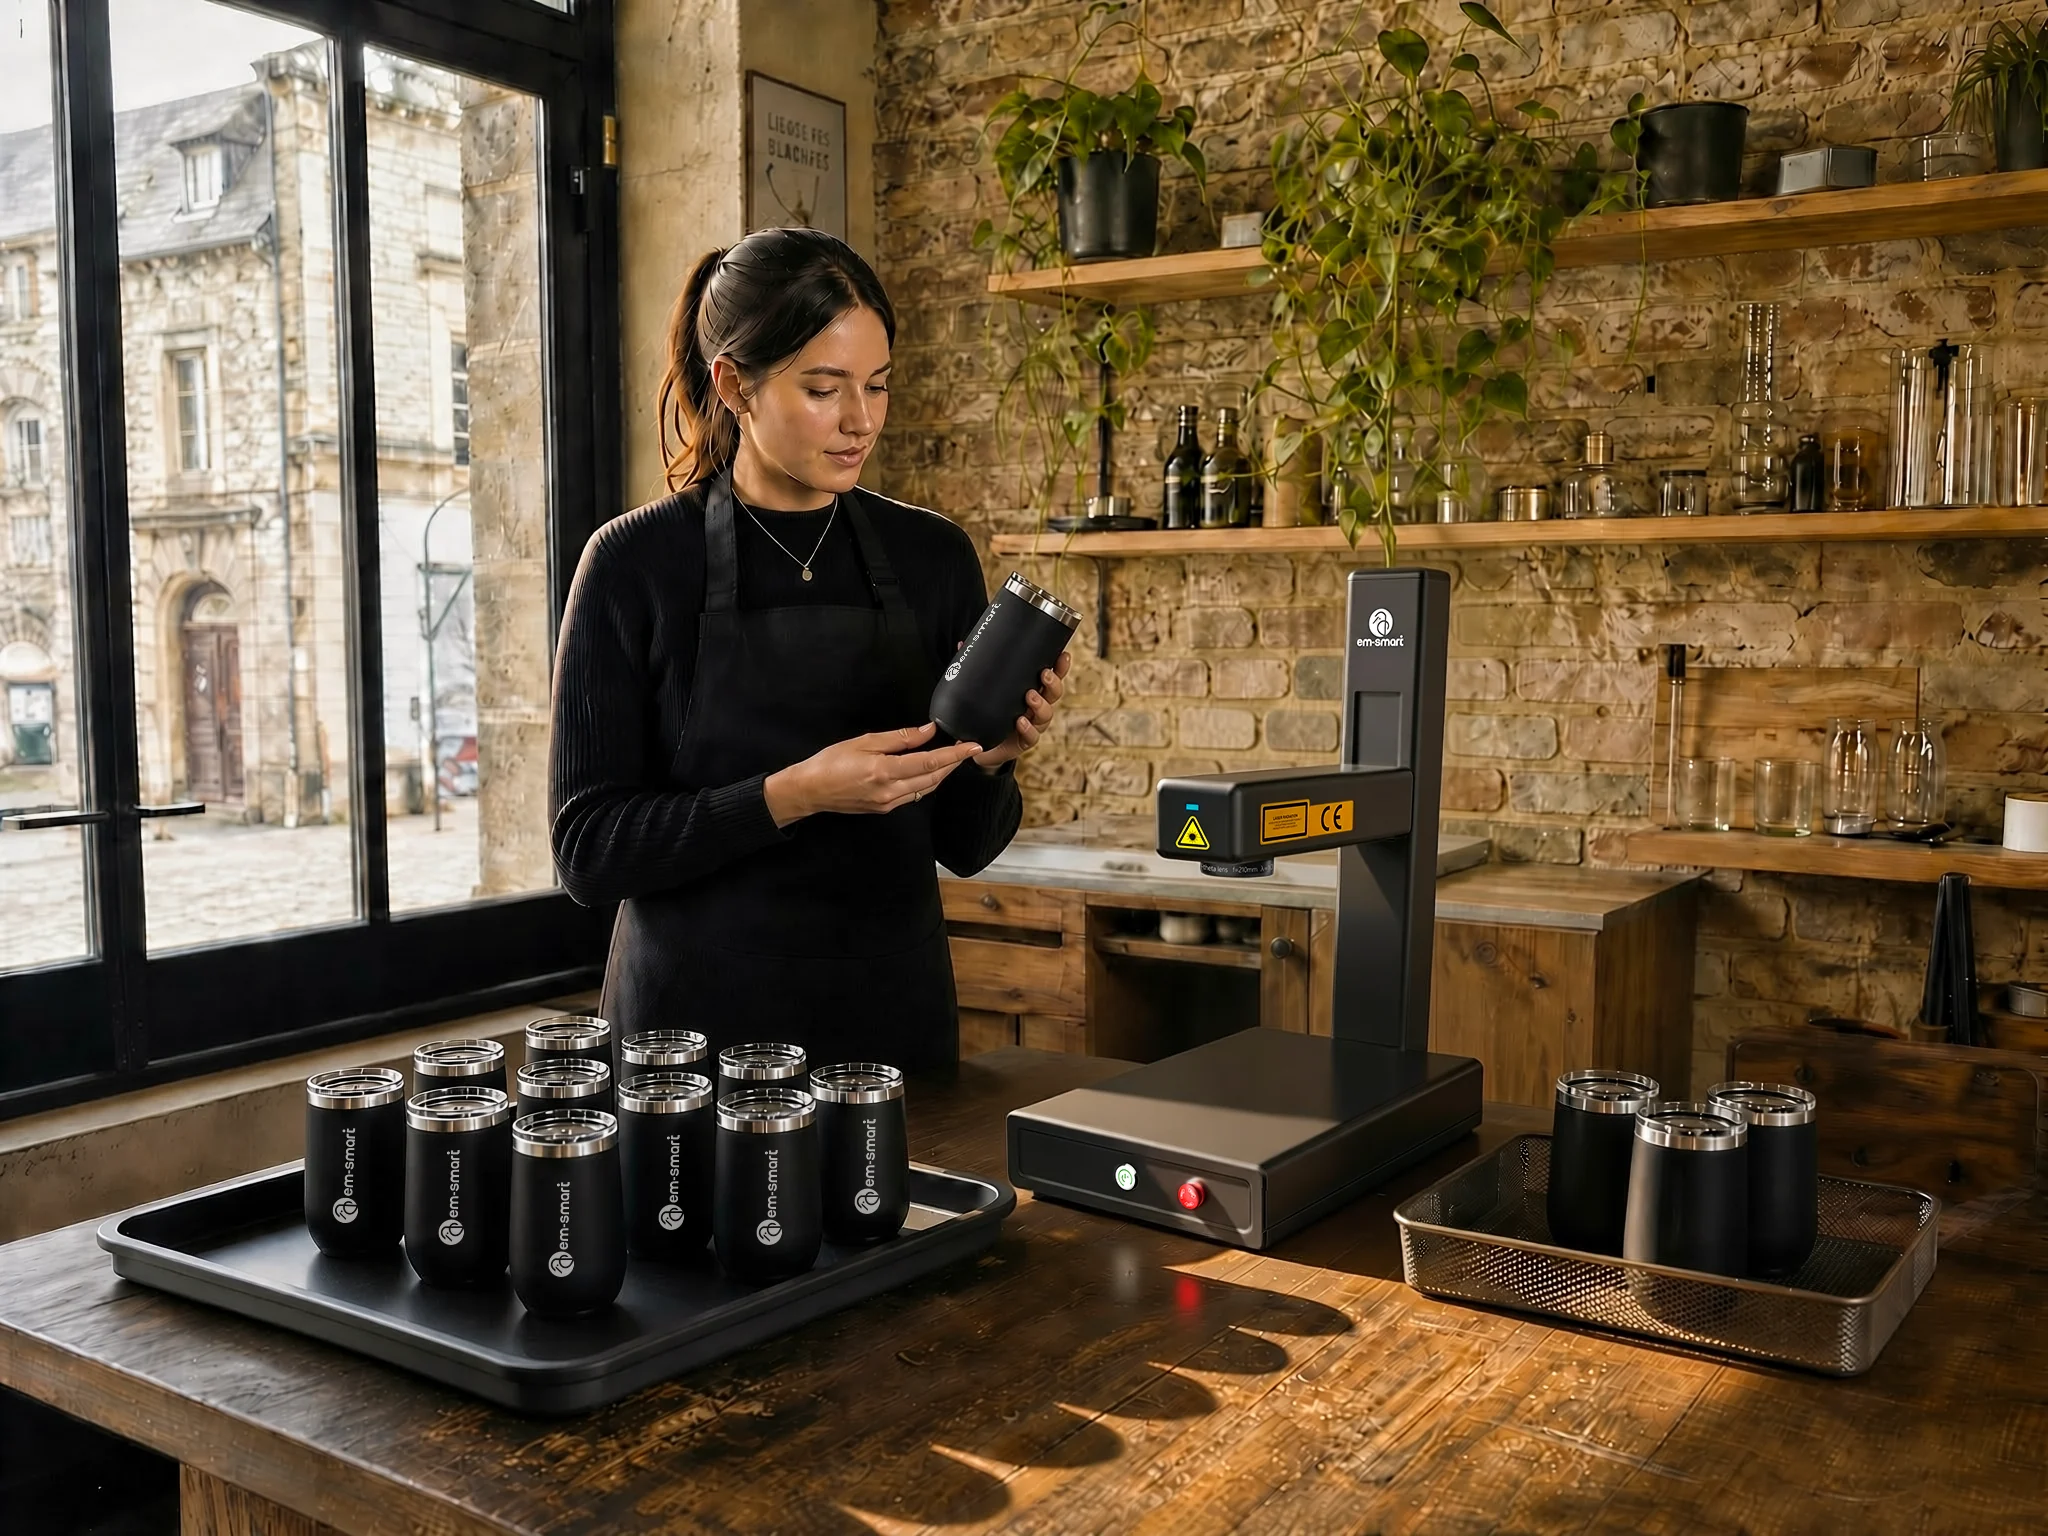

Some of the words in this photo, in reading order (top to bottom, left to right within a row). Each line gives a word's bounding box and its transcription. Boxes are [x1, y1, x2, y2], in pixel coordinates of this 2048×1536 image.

[959, 603, 1002, 663] em-smart
[1356, 634, 1404, 647] em-smart
[343, 1127, 356, 1197] em-smart
[447, 1149, 461, 1218] em-smart
[667, 1134, 681, 1203] em-smart
[765, 1149, 779, 1219] em-smart
[863, 1118, 877, 1187] em-smart
[556, 1181, 571, 1250] em-smart
